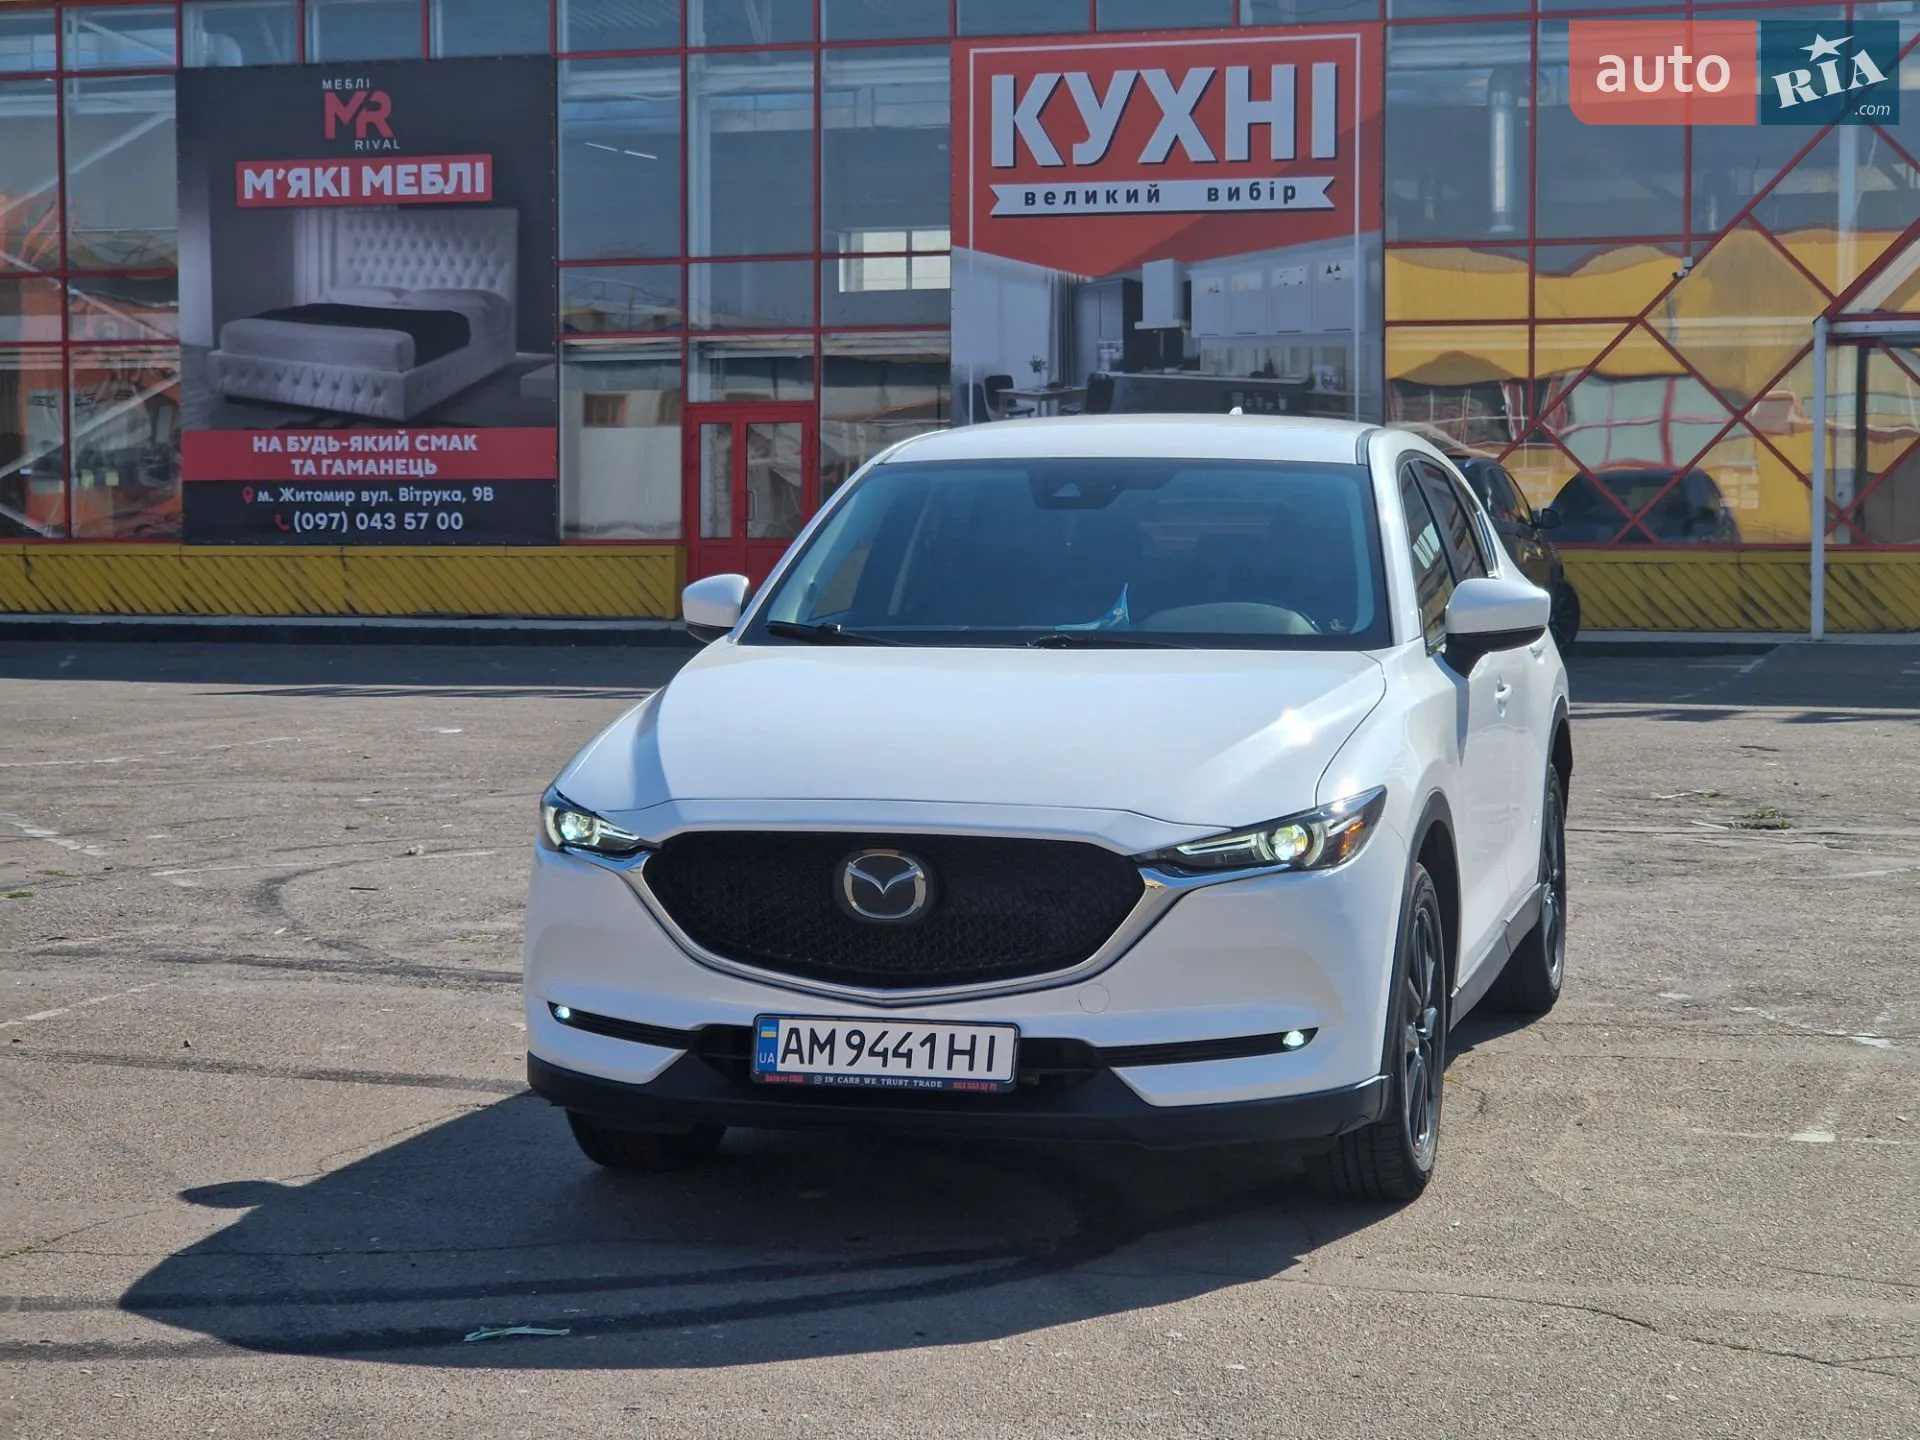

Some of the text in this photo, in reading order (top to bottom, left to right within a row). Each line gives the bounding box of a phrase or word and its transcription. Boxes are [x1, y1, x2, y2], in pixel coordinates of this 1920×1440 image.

[322, 78, 371, 90] МЕБЛІ
[991, 62, 1337, 168] КУХНІ
[354, 139, 401, 151] RIVAL
[243, 162, 485, 200] М'ЯКІ МЕБЛІ
[1023, 181, 1297, 207] великий вибір
[252, 431, 478, 455] НА БУДЬ-ЯКИЙ СМАК
[291, 458, 438, 478] ТА ГАМАНЕЦЬ
[257, 490, 274, 502] м.
[279, 487, 355, 506] Житомир
[360, 489, 393, 506] вул.
[399, 486, 466, 505] Вітрука,
[294, 512, 463, 533] (097) 043 57 00
[759, 1052, 776, 1065] UA
[824, 1076, 834, 1084] IN
[837, 1076, 860, 1085] CARS
[863, 1077, 877, 1086] WE
[880, 1078, 909, 1087] TRUST
[912, 1079, 943, 1088] TRADE
